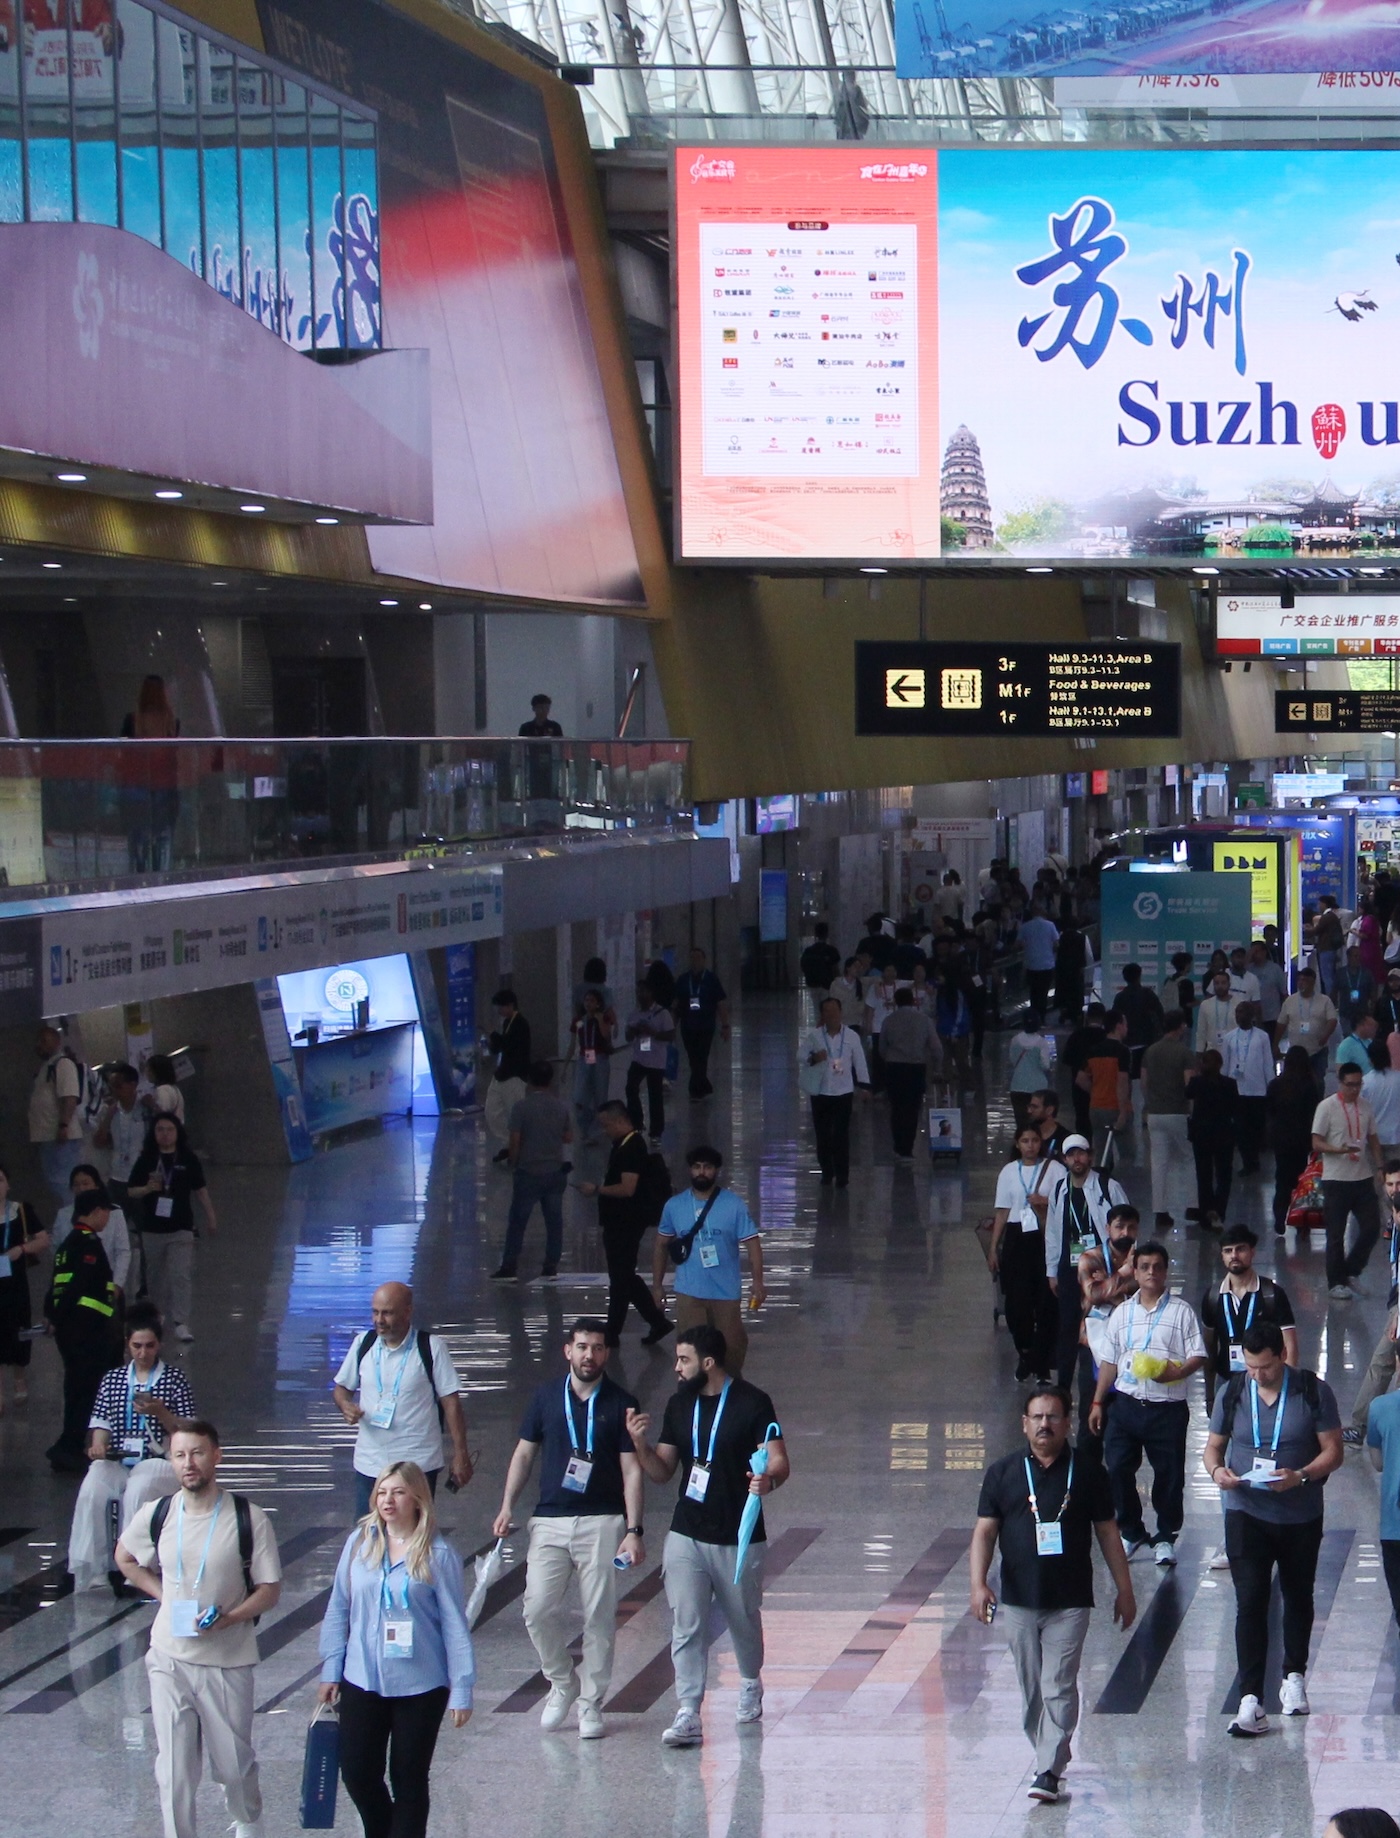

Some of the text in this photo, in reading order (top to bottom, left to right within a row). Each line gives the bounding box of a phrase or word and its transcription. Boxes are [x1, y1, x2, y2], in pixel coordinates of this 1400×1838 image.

[1015, 197, 1253, 377] 苏州
[1280, 614, 1400, 628] 广交会企业推广服务
[998, 657, 1016, 672] 3F
[1049, 654, 1070, 664] Hall
[1143, 654, 1152, 664] B
[998, 684, 1031, 698] M1F
[1049, 680, 1151, 692] Food & Beverages
[999, 710, 1017, 724] 1F
[1049, 706, 1070, 716] Hall
[1143, 706, 1152, 716] B
